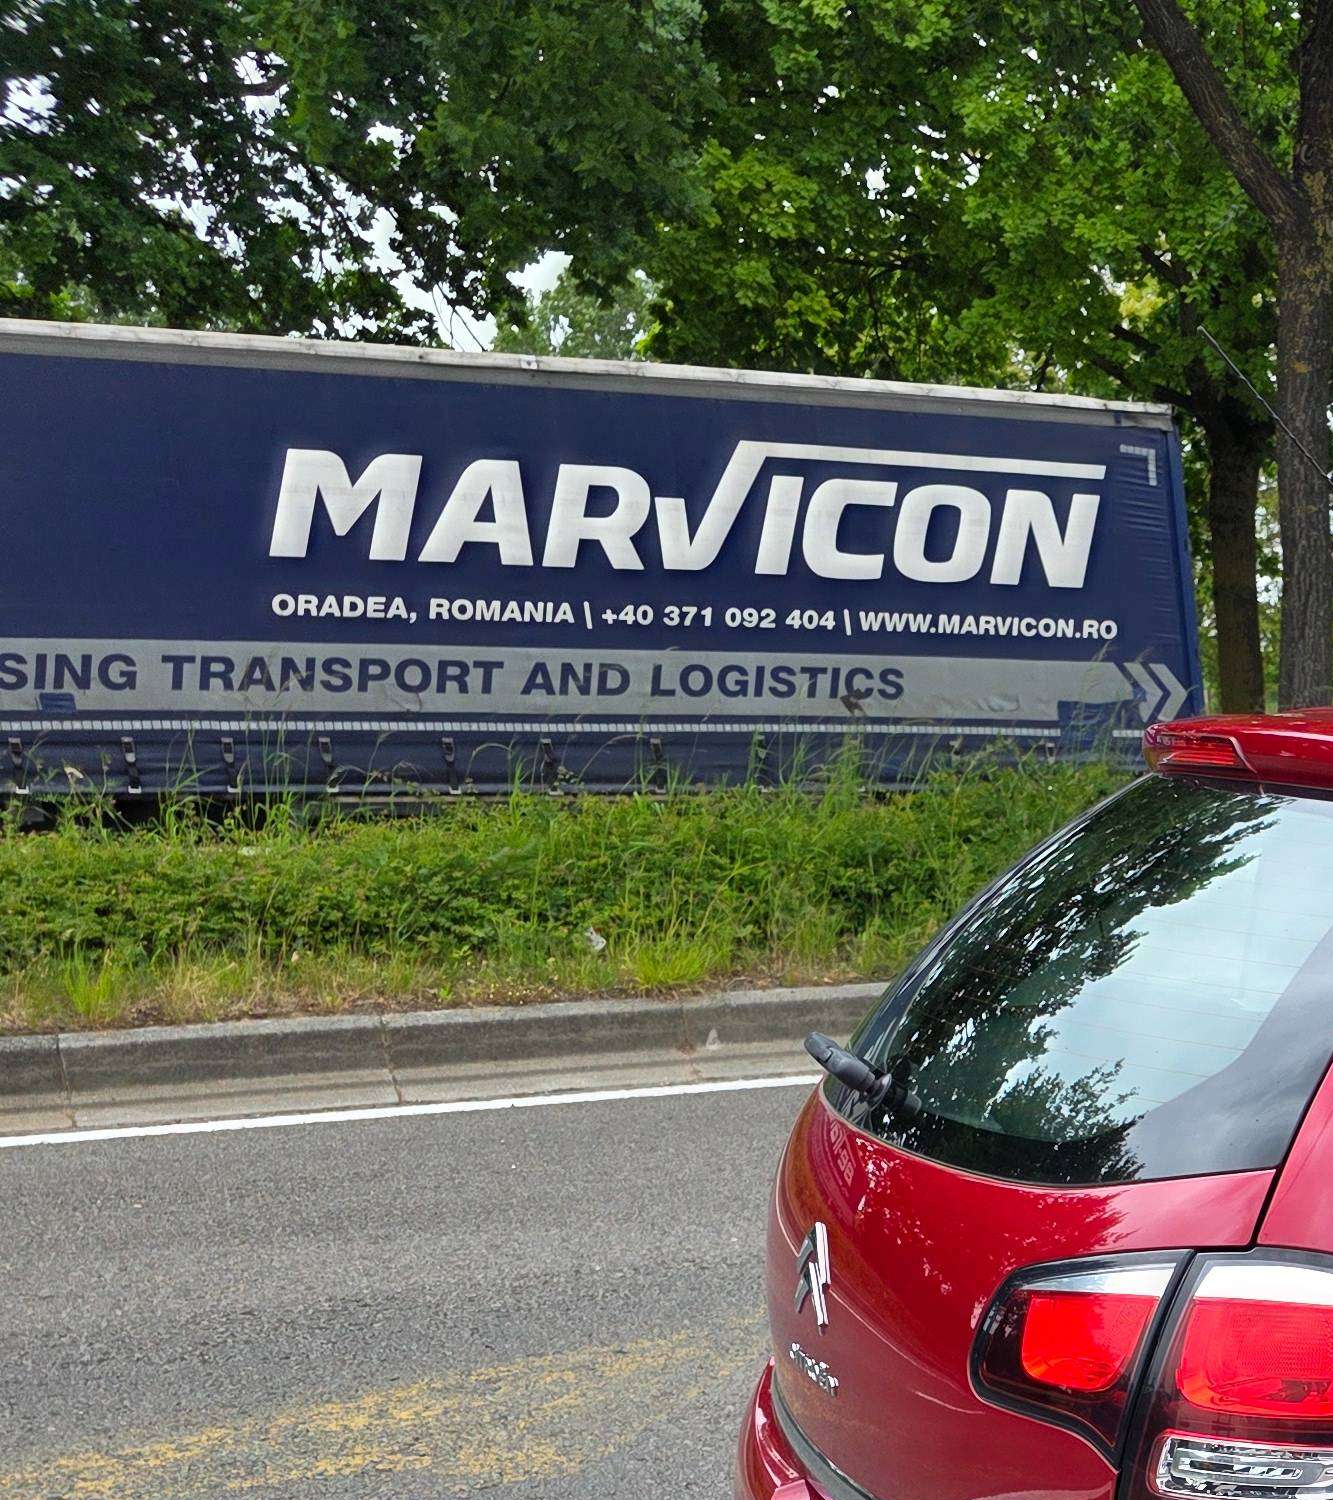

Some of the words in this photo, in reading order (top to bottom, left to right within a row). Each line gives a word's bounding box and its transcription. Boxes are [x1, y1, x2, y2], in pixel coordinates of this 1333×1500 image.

[268, 440, 1107, 589] MARVICON
[271, 593, 417, 624] ORADEA,
[428, 597, 575, 624] ROMANIA
[601, 604, 654, 626] +40
[662, 605, 713, 627] 371
[724, 607, 777, 629] 092
[785, 609, 836, 631] 404
[858, 610, 1118, 641] WWW.MARVICON.RO
[161, 654, 505, 696] TRANSPORT
[520, 662, 631, 697] AND
[650, 663, 905, 701] LOGISTICS
